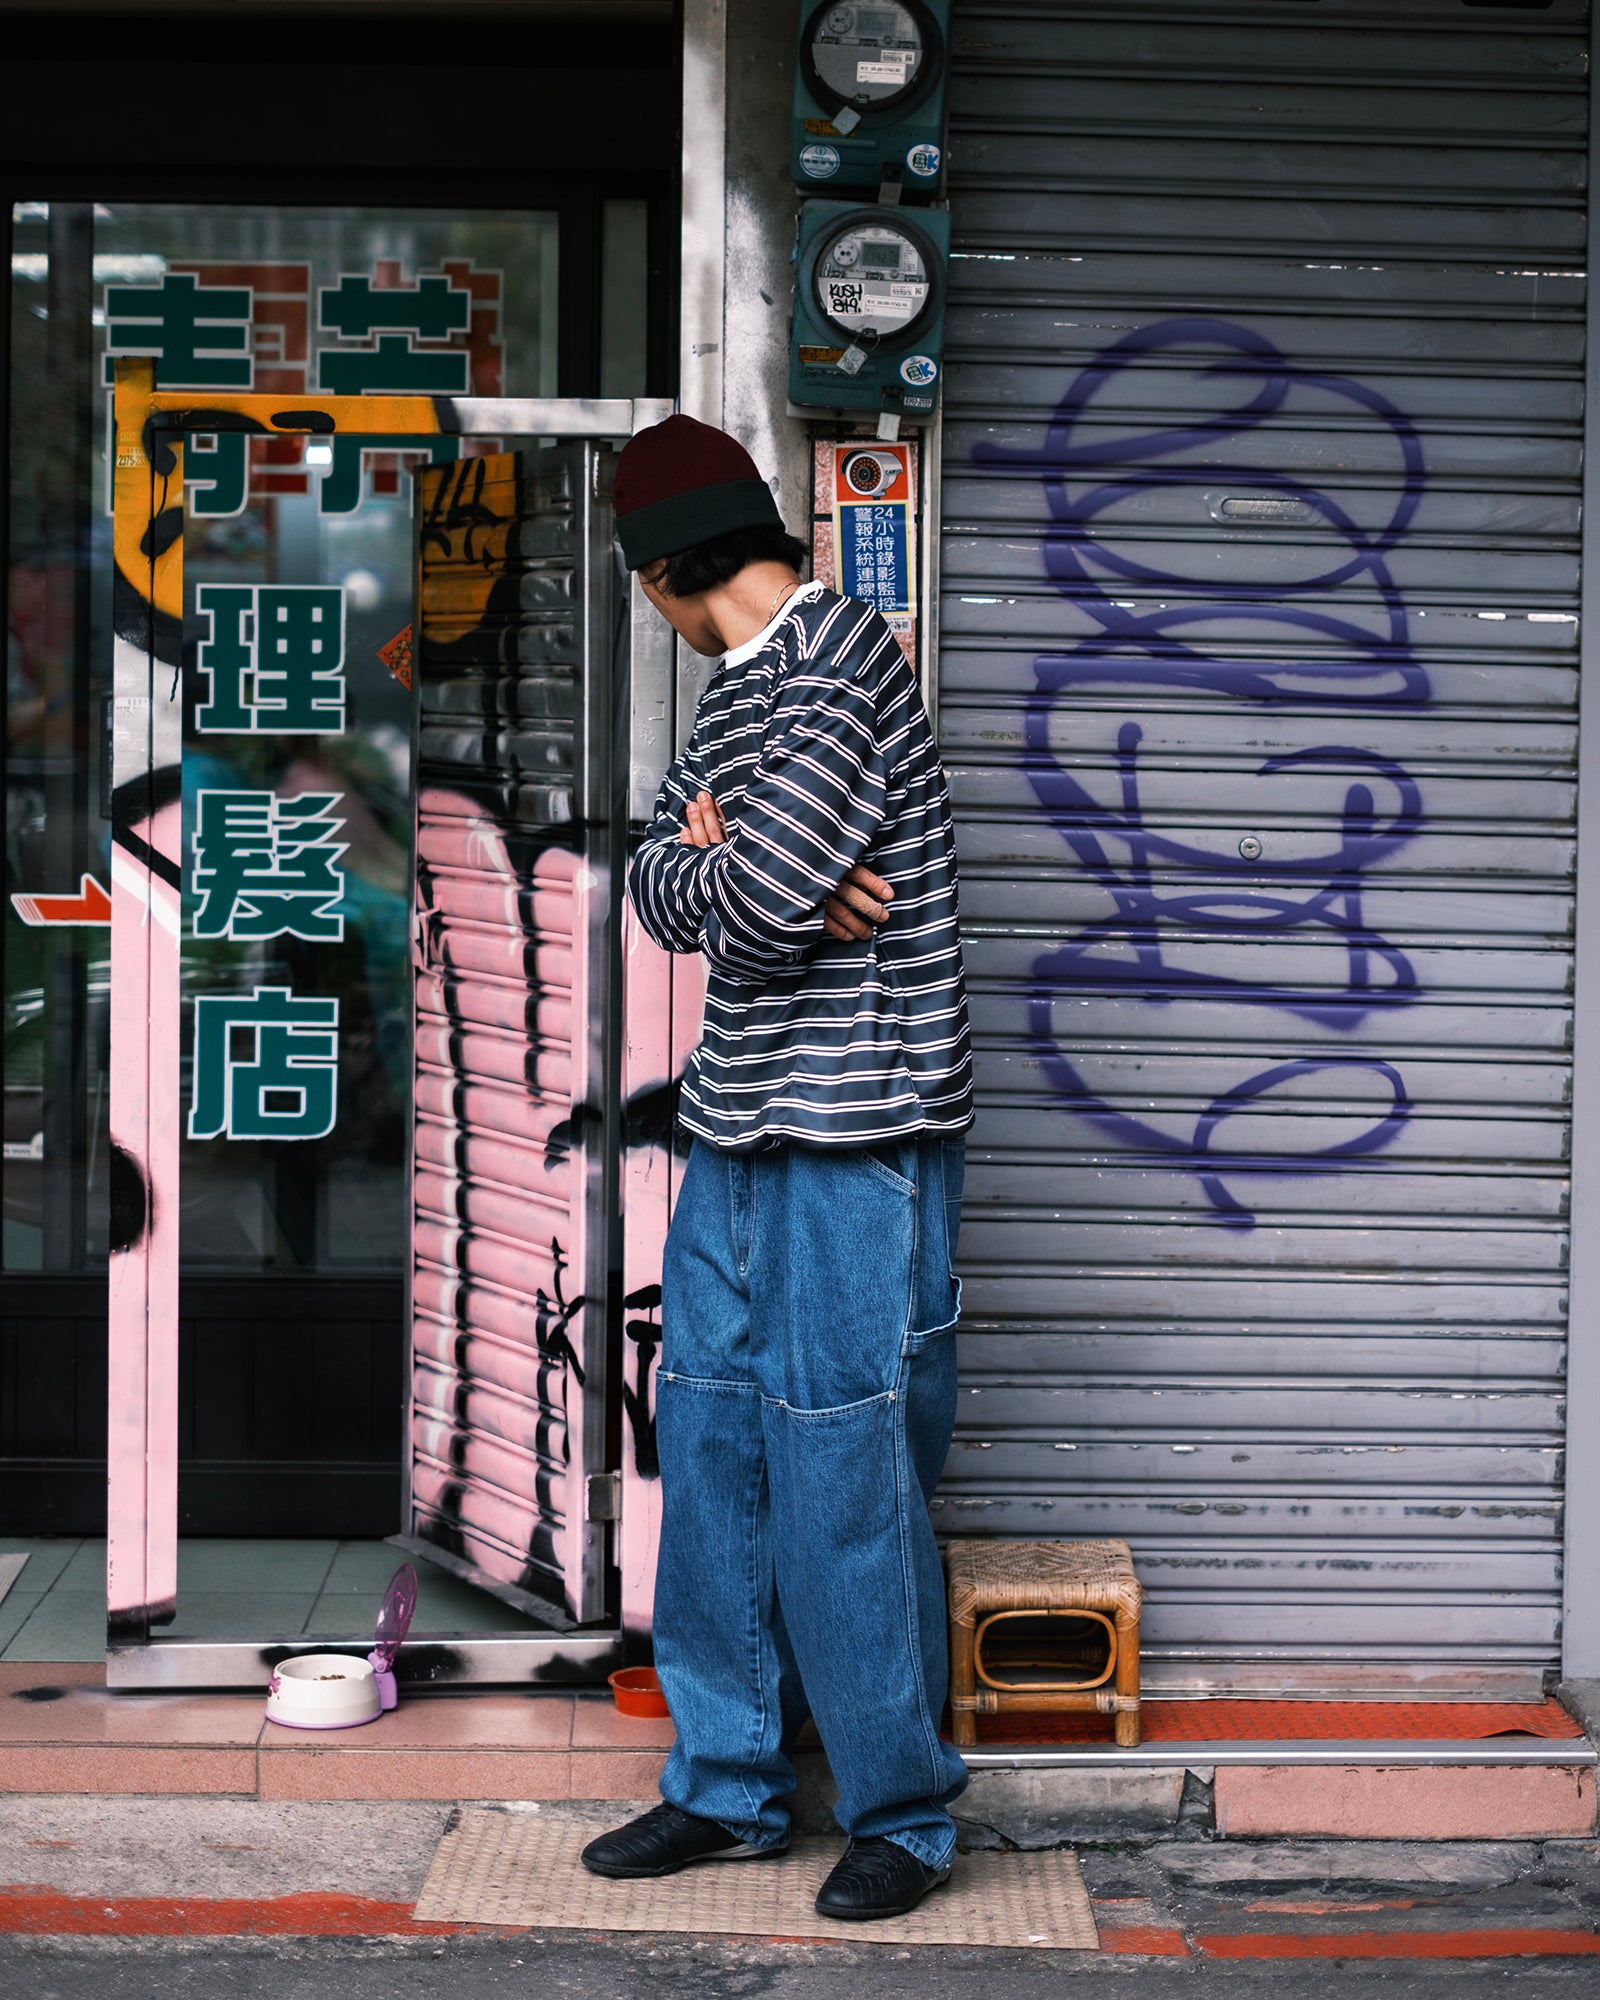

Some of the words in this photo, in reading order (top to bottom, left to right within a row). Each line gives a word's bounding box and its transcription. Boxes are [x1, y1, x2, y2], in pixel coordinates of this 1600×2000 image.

[829, 283, 862, 300] KUSH
[874, 507, 897, 611] 24小時錄影監控
[187, 583, 350, 1141] 理髮店
